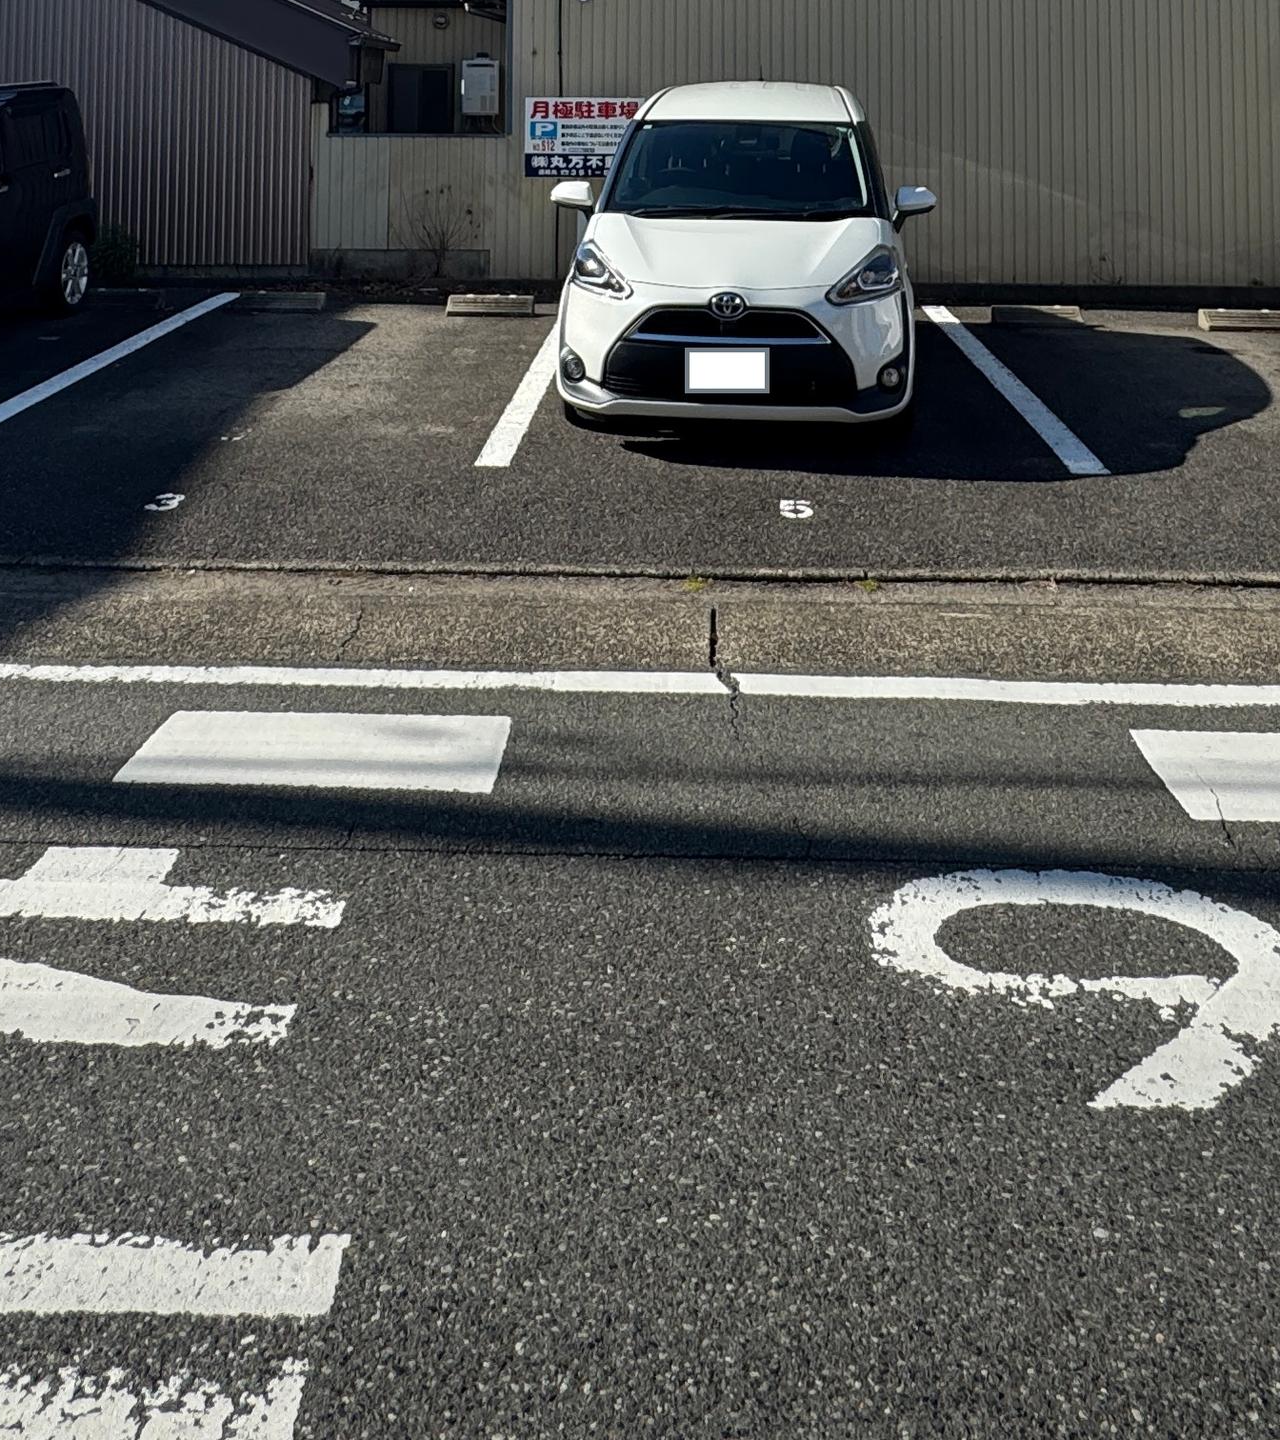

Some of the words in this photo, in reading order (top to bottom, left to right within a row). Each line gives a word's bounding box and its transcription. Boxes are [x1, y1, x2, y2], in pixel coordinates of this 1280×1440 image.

[530, 101, 639, 119] 月極駐車場
[535, 122, 555, 136] P
[144, 492, 186, 511] 3
[779, 499, 814, 519] 5
